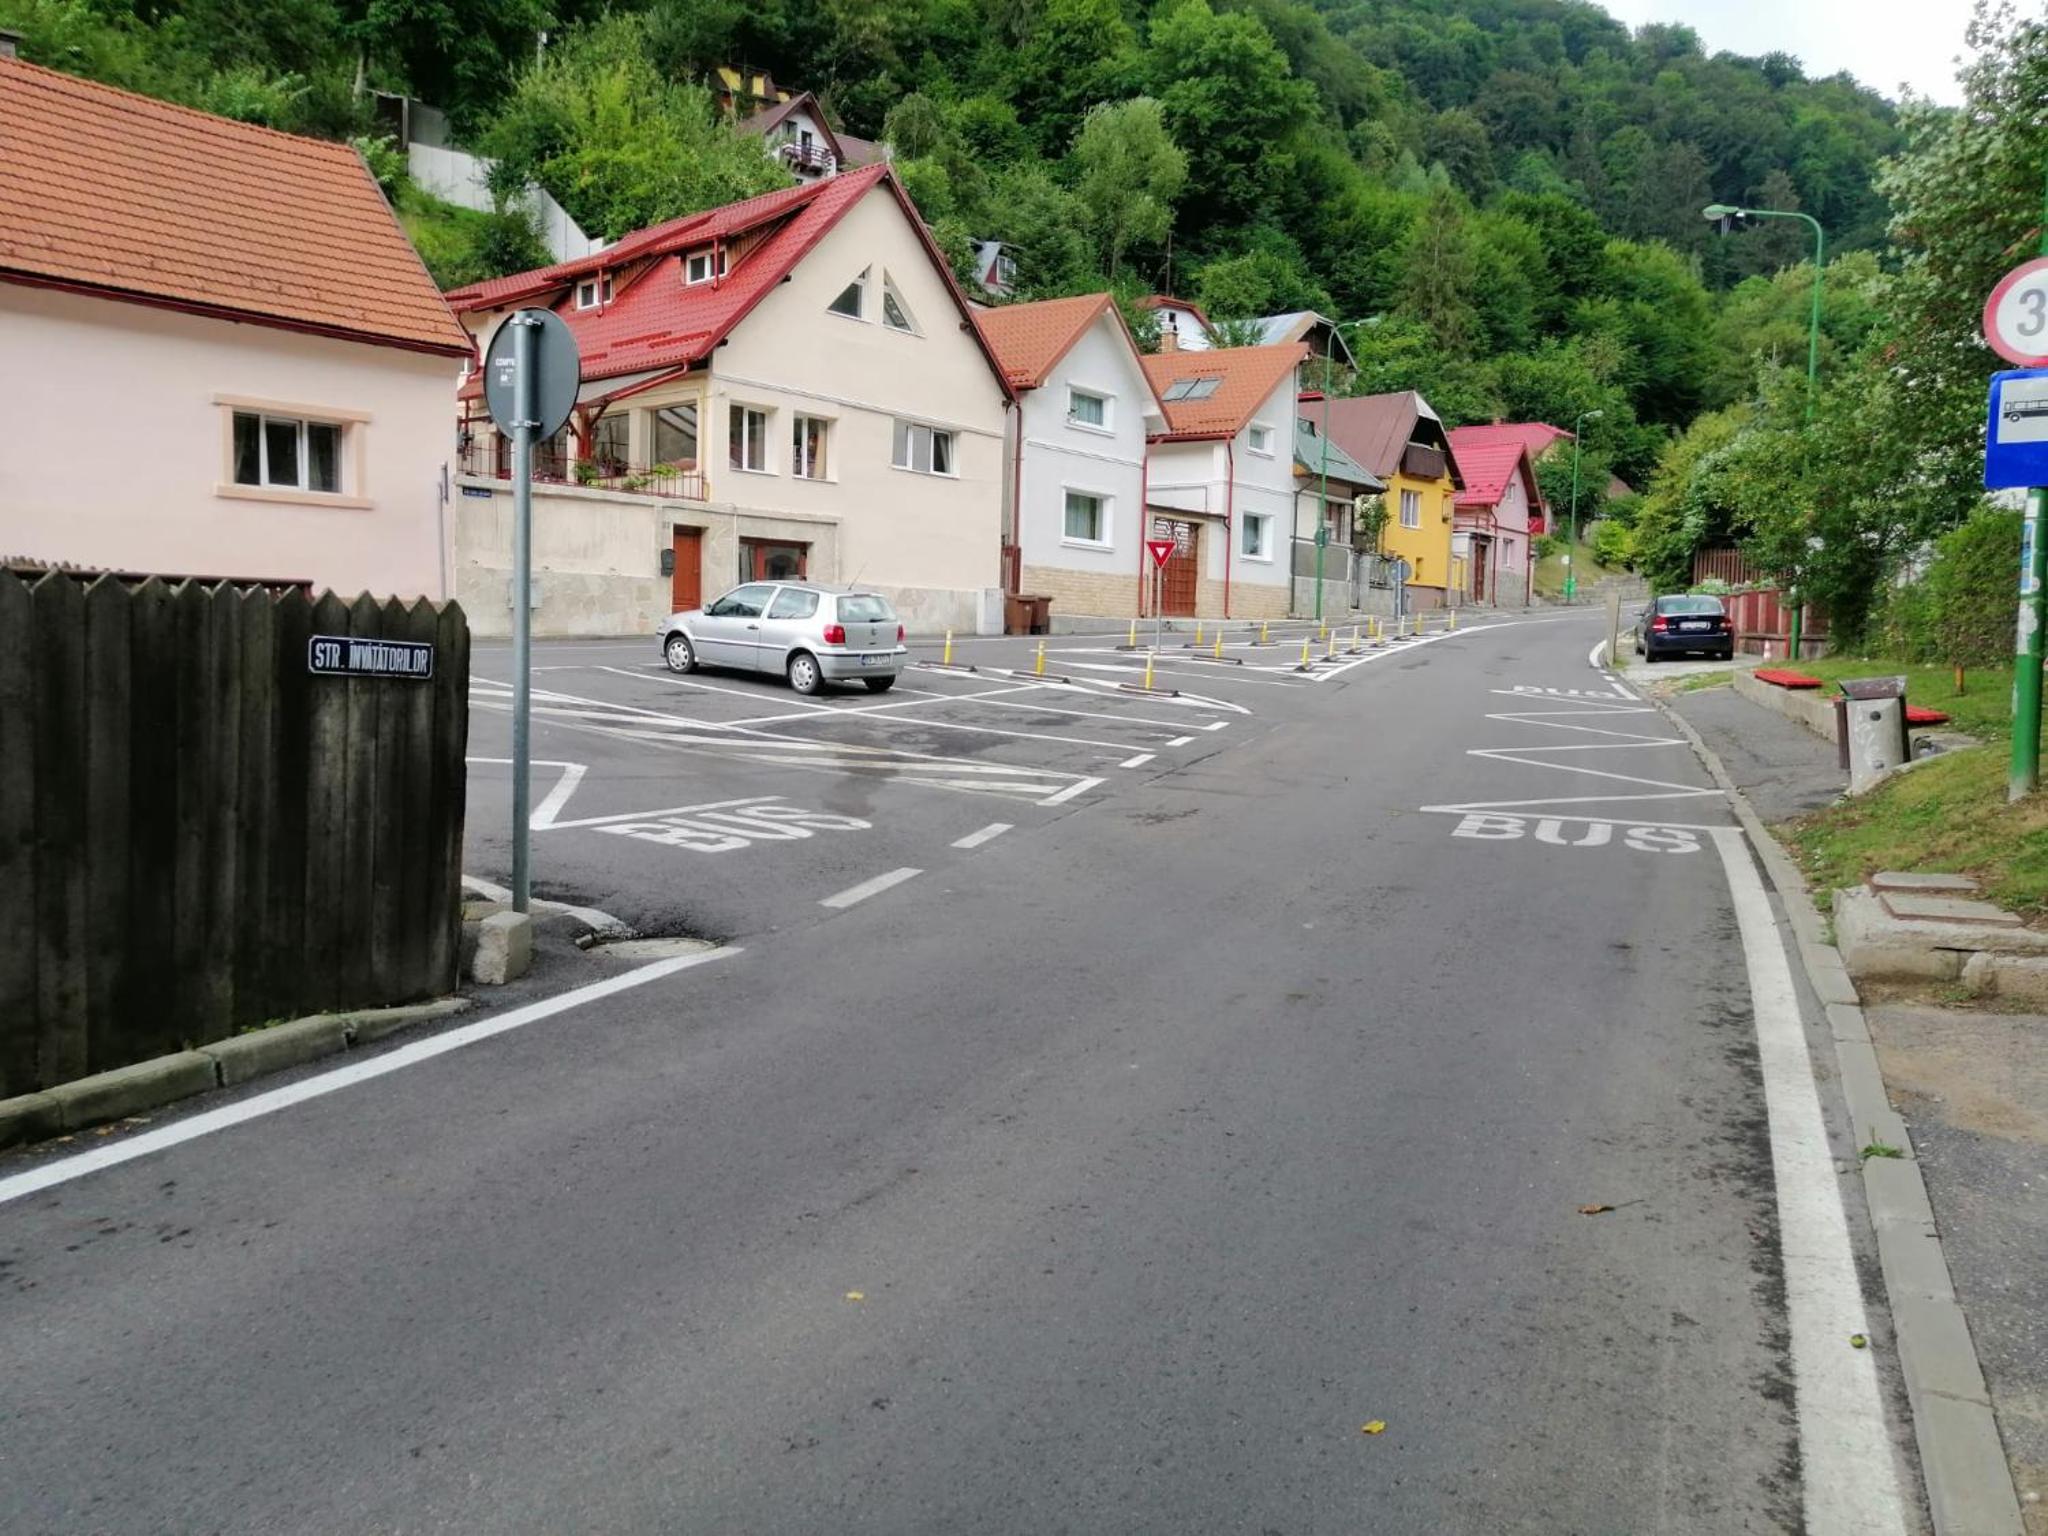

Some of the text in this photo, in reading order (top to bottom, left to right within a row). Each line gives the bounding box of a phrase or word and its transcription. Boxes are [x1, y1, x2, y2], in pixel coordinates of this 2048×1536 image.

[315, 643, 345, 668] STR.
[592, 806, 872, 853] BUS
[1451, 814, 1702, 854] BUS
